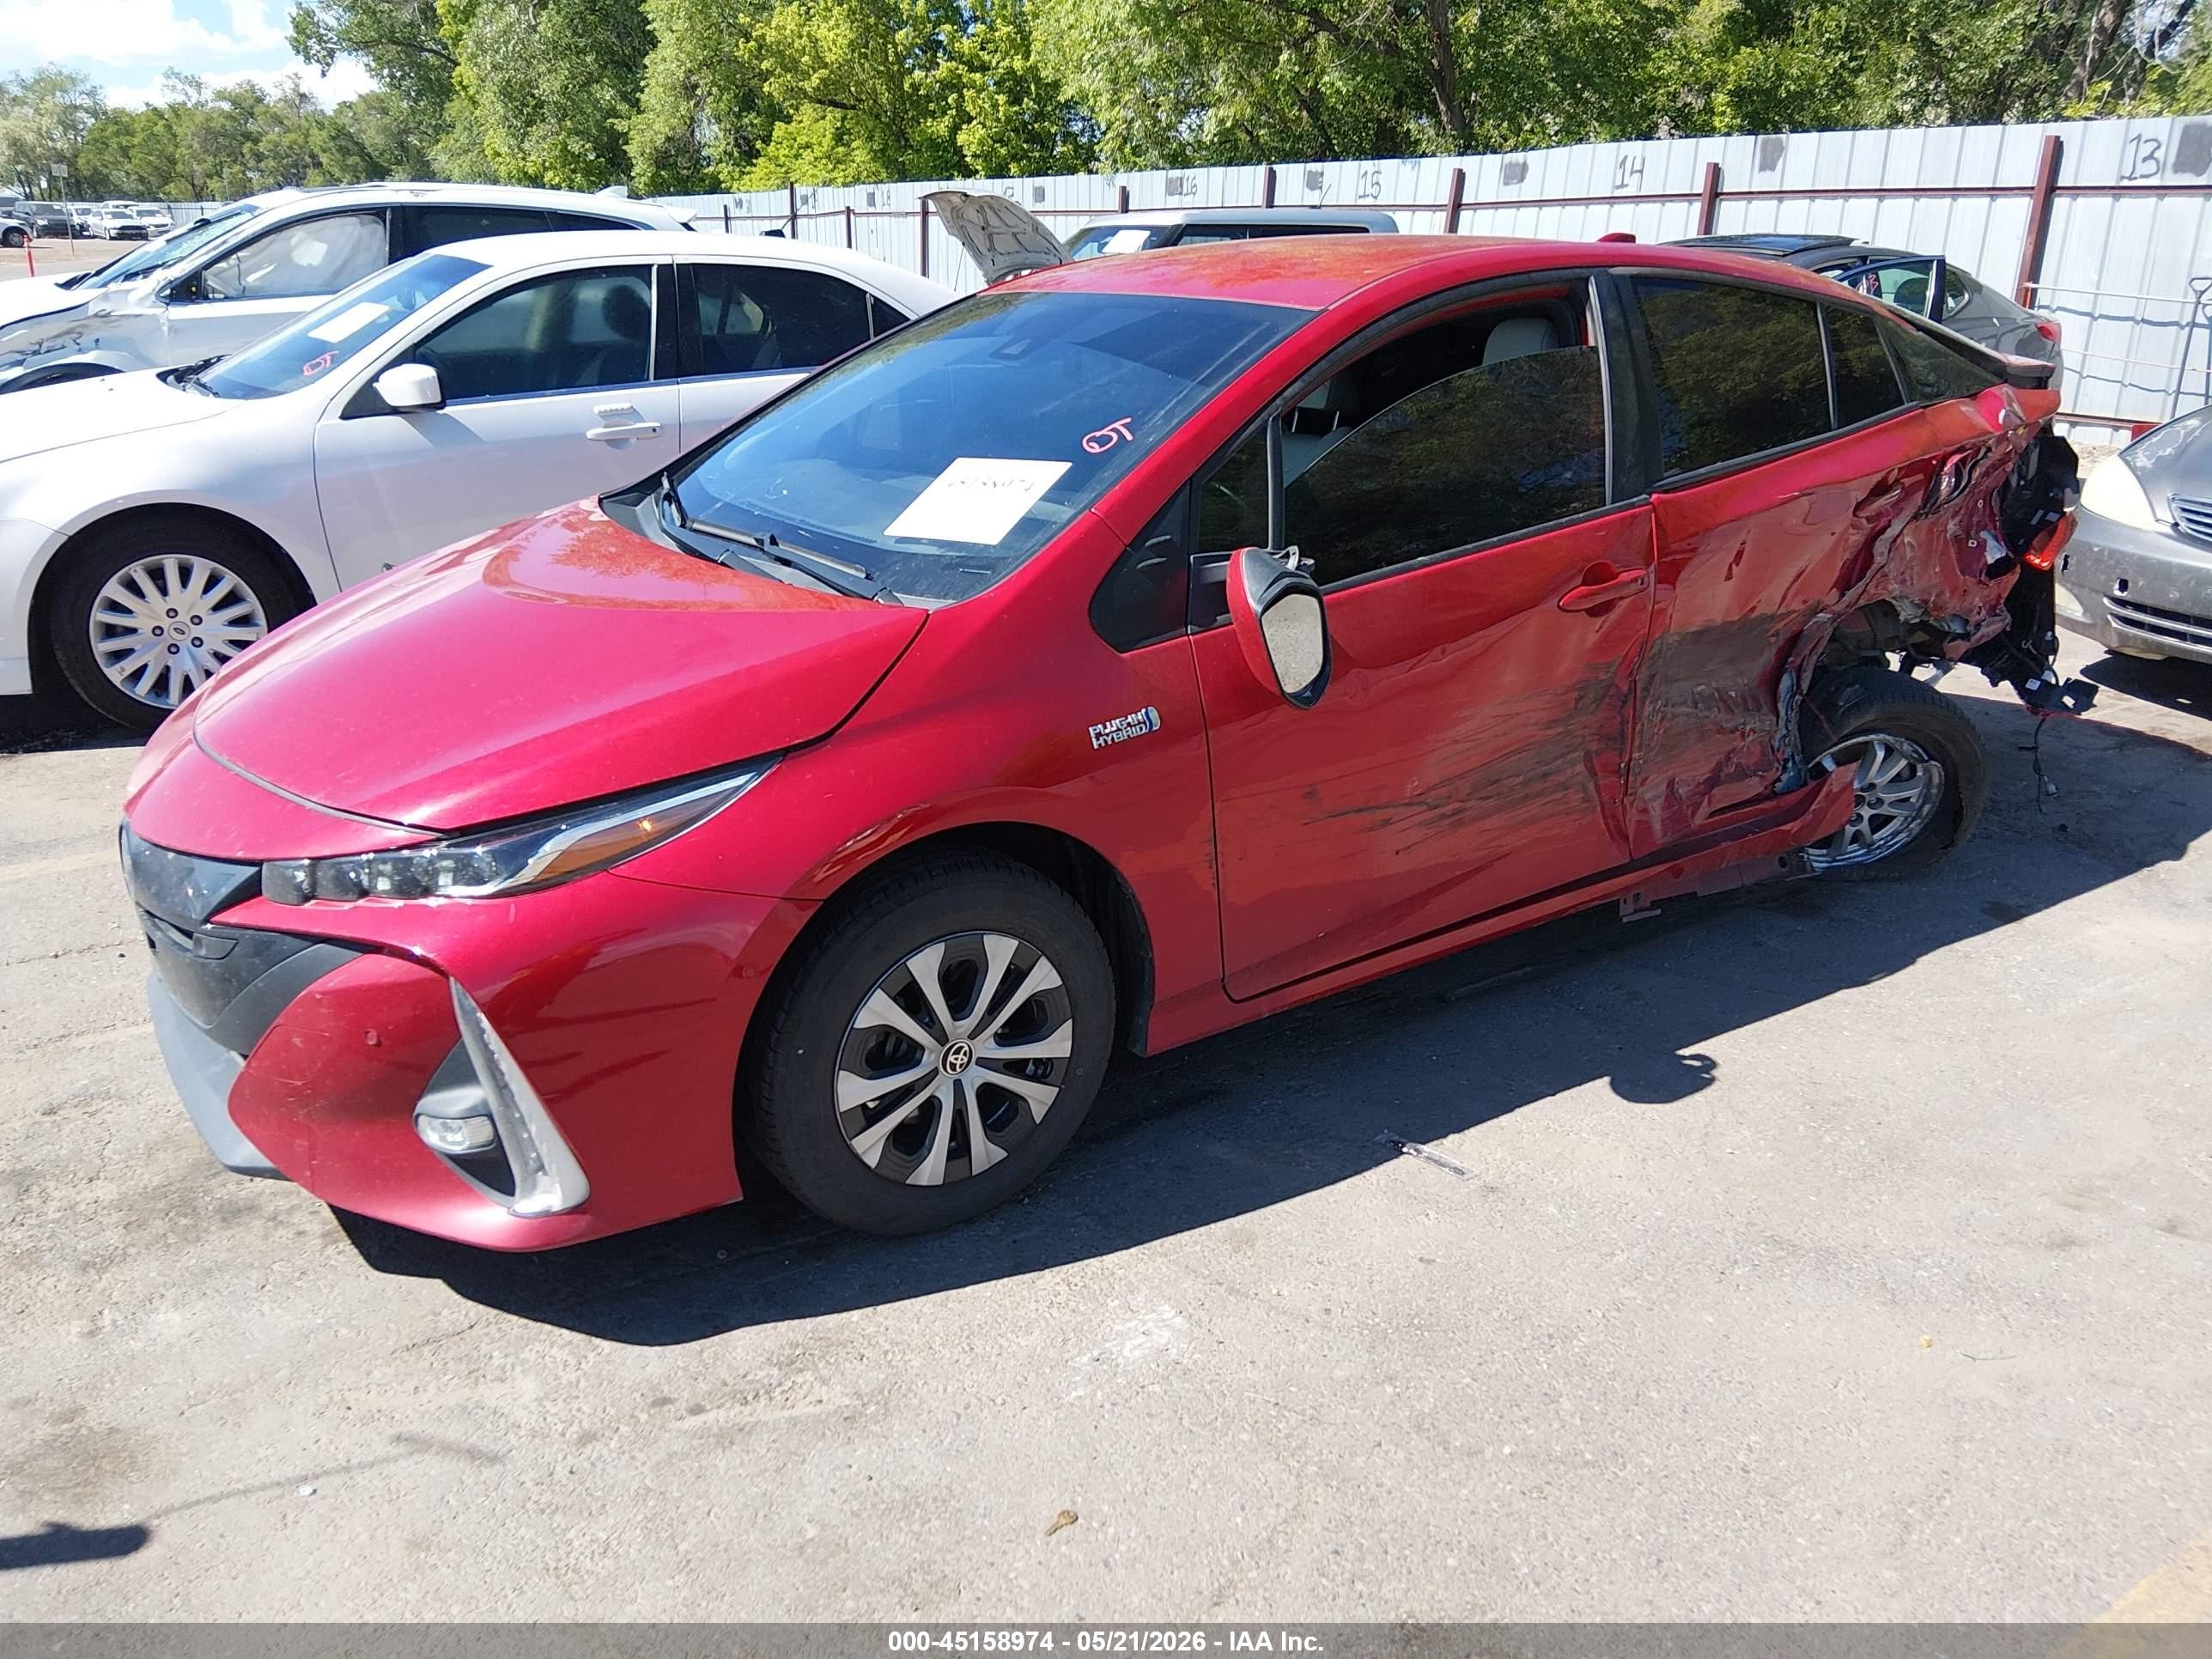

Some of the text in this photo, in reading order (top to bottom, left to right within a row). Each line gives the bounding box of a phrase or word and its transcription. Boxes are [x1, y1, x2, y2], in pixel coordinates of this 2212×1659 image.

[2120, 133, 2161, 181] 13
[1183, 175, 1198, 197] 16
[1358, 170, 1382, 199] 15
[1614, 154, 1646, 193] 14
[1091, 723, 1147, 750] HYBRID
